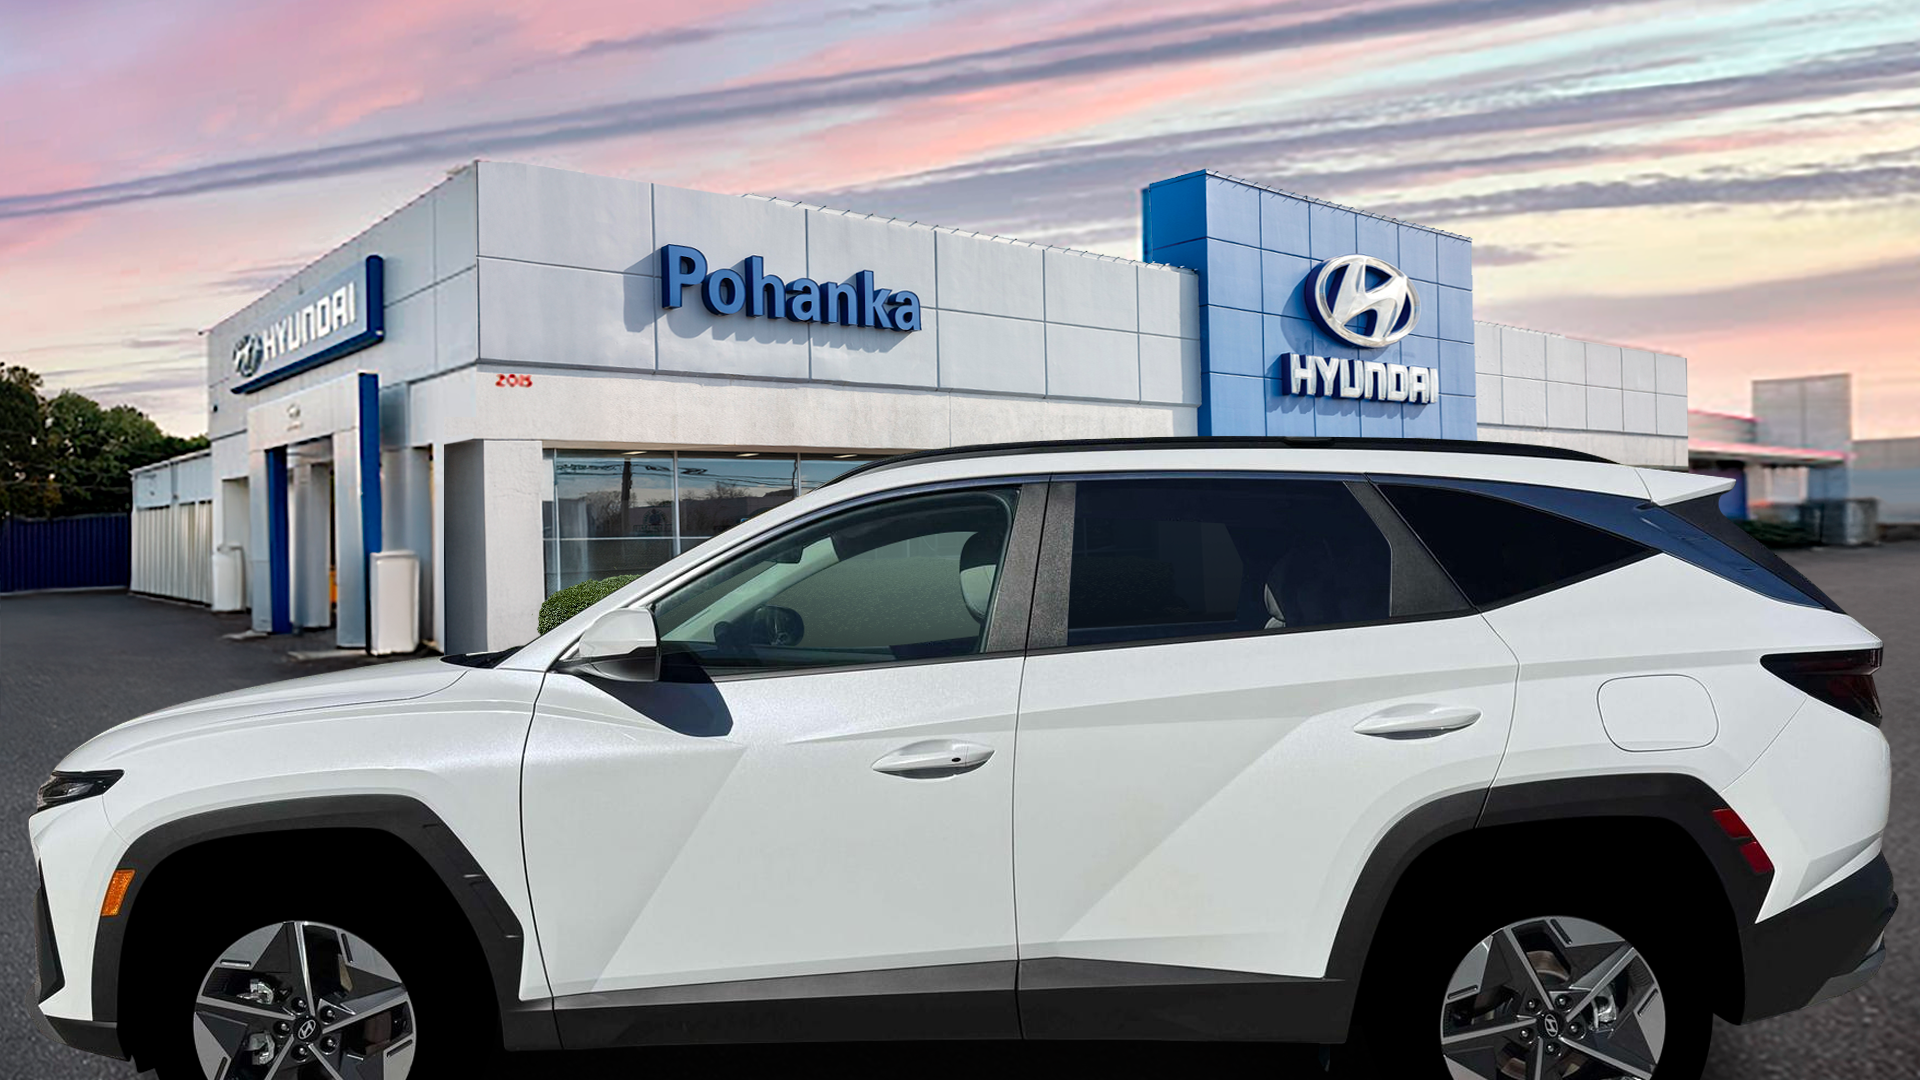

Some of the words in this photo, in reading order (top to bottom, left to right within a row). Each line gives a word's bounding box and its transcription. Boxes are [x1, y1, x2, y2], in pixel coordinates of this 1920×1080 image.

[262, 282, 356, 362] HYUNDAI
[661, 244, 922, 332] Pohanka
[1286, 353, 1439, 404] HYUNDAI
